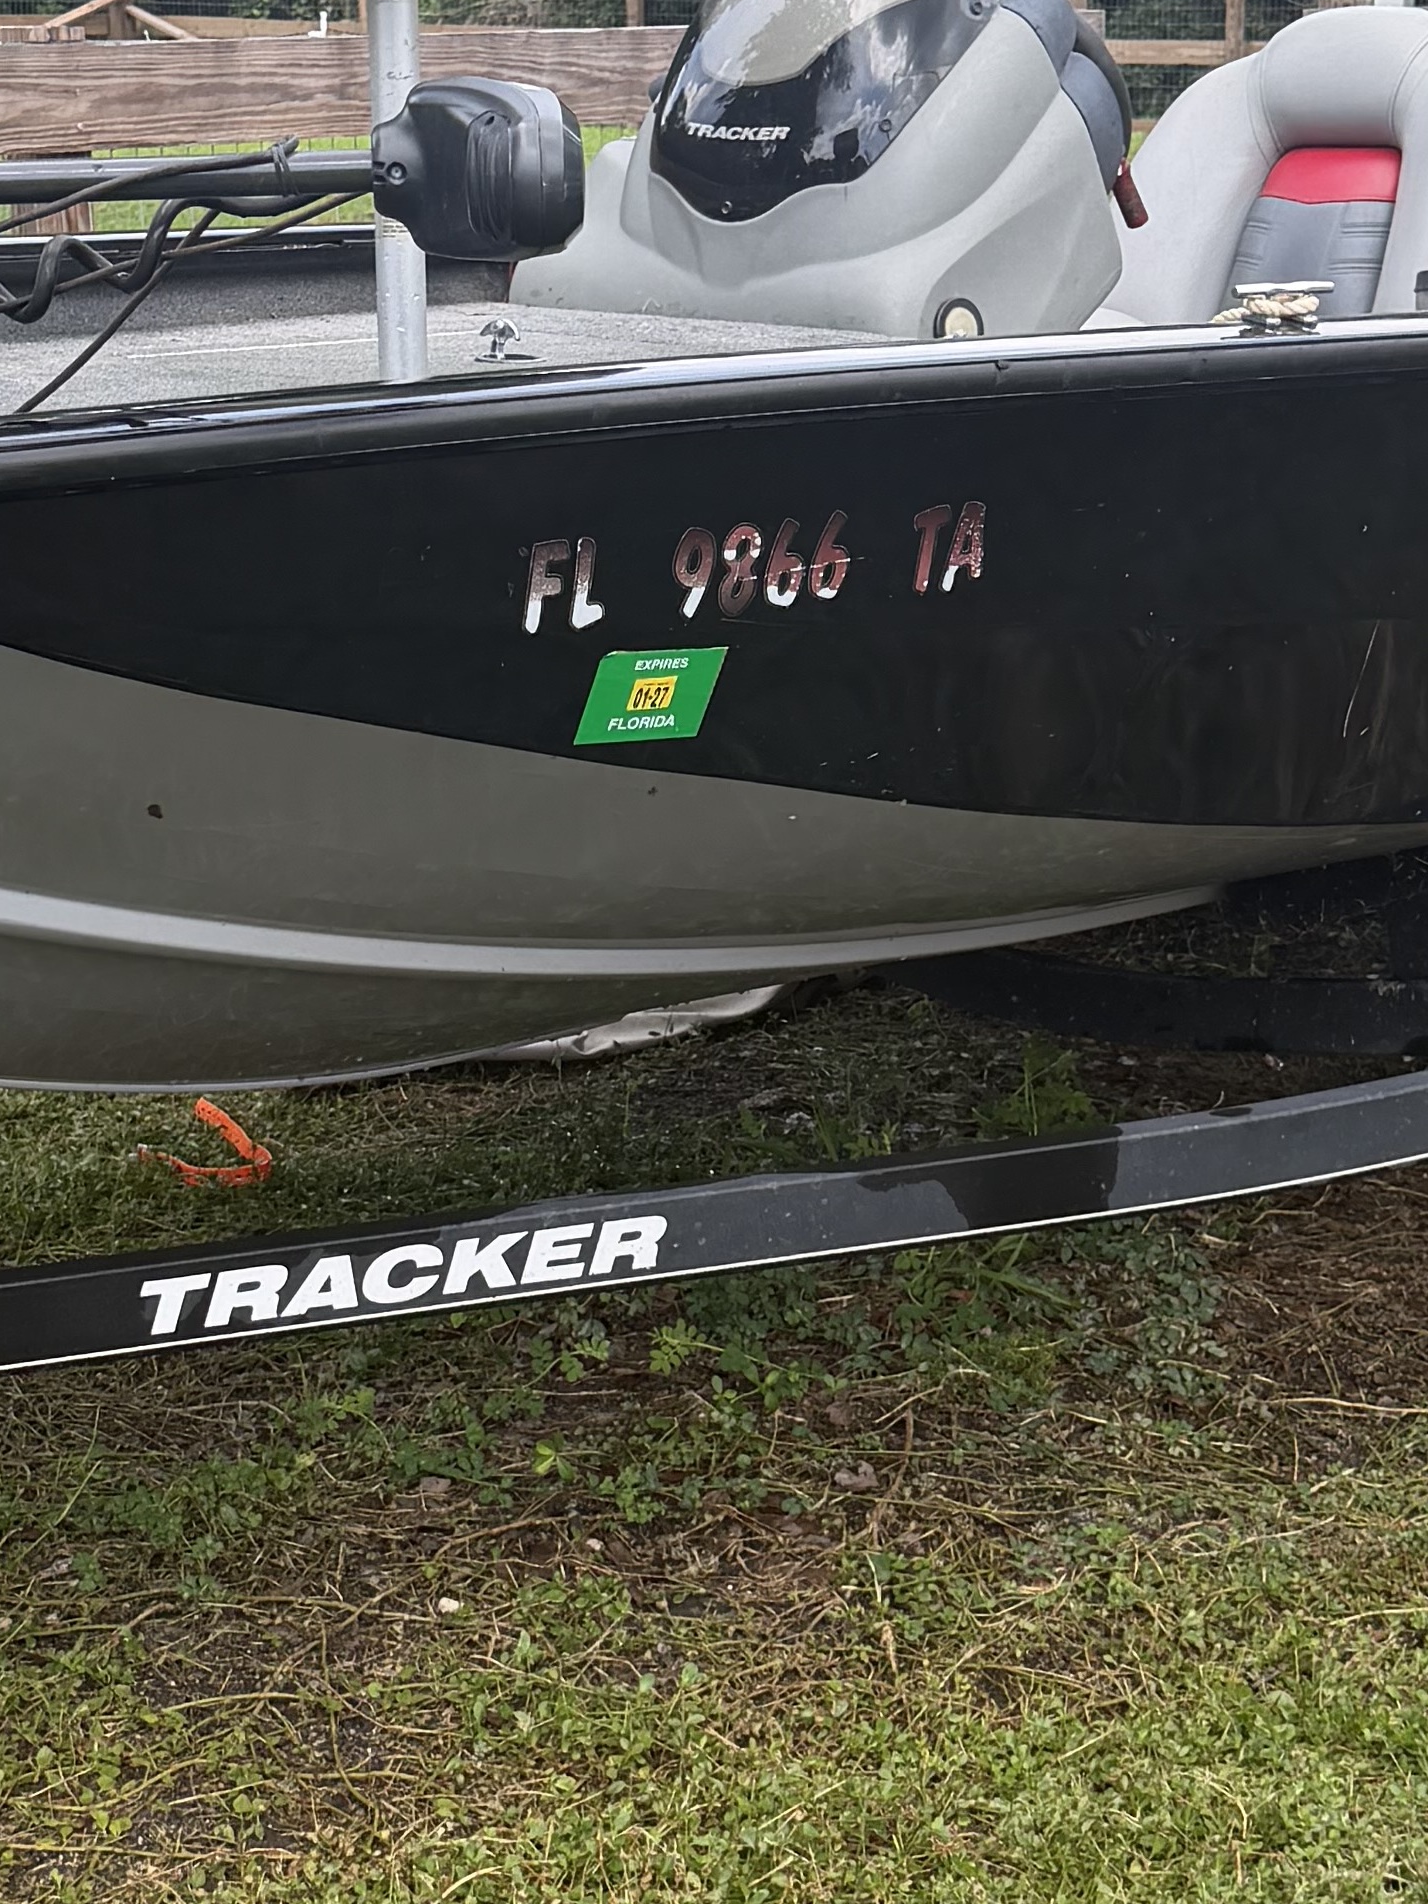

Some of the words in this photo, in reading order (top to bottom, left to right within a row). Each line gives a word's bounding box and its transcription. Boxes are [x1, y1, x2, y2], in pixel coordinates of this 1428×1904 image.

[686, 122, 790, 141] TRACKER
[522, 536, 606, 634] FL
[672, 510, 851, 618] 9866
[913, 501, 987, 594] TA
[634, 657, 689, 671] EXPIRES
[607, 714, 675, 732] FLORIDA
[139, 1215, 668, 1336] TRACKER
